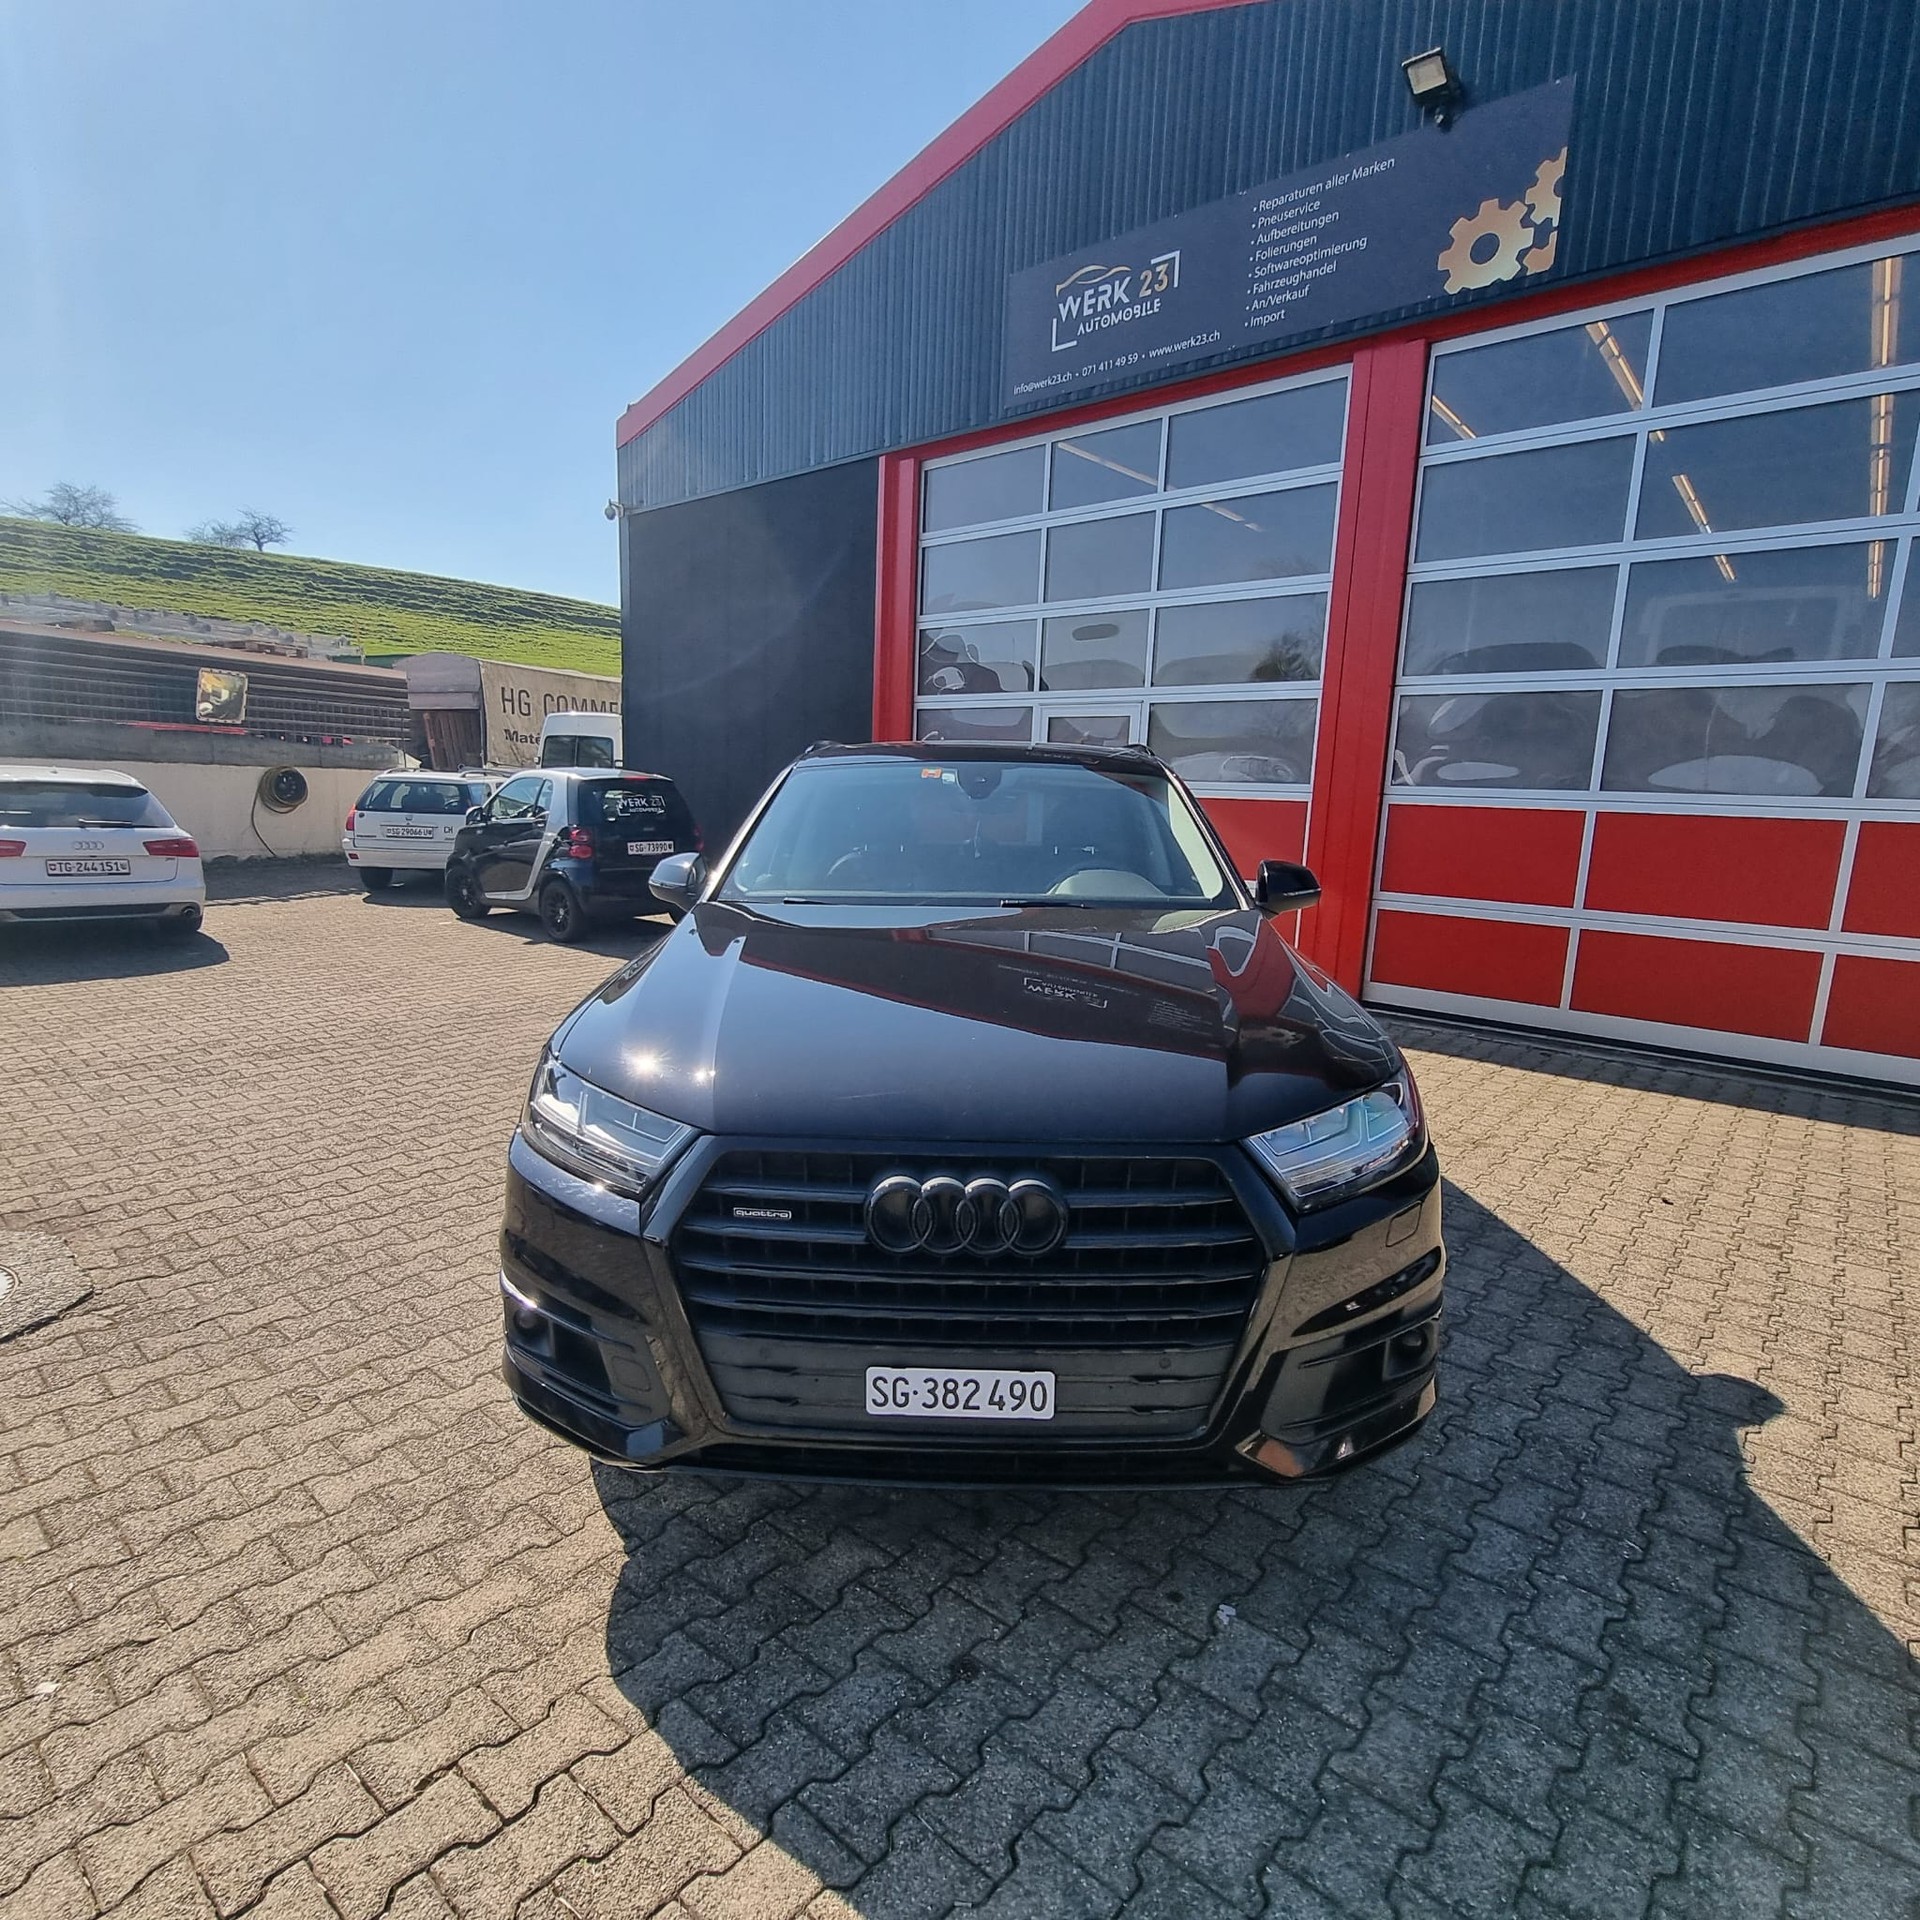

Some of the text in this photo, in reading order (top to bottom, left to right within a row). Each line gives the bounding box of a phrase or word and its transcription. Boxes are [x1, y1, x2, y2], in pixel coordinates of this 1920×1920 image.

[1259, 158, 1395, 212] Reparaturen aller Marken
[1256, 211, 1339, 246] Aufbereitungen
[1258, 200, 1320, 228] Pneuservice
[1254, 236, 1367, 279] Softwareoptimierung
[1255, 235, 1317, 262] Folierungen
[1058, 263, 1170, 322] WERK 23
[1253, 260, 1337, 295] Fahrzeughandel
[1251, 284, 1310, 311] An/Verkauf
[1077, 298, 1162, 336] AUTOMOBILE
[1250, 309, 1285, 328] Import
[1013, 371, 1072, 395] info@werk23.ch
[1082, 364, 1096, 376] 071
[1098, 360, 1113, 372] 411
[1148, 329, 1221, 358] www.werk23.ch
[501, 686, 531, 716] HG
[443, 826, 453, 834] CH
[736, 1210, 788, 1218] quattro
